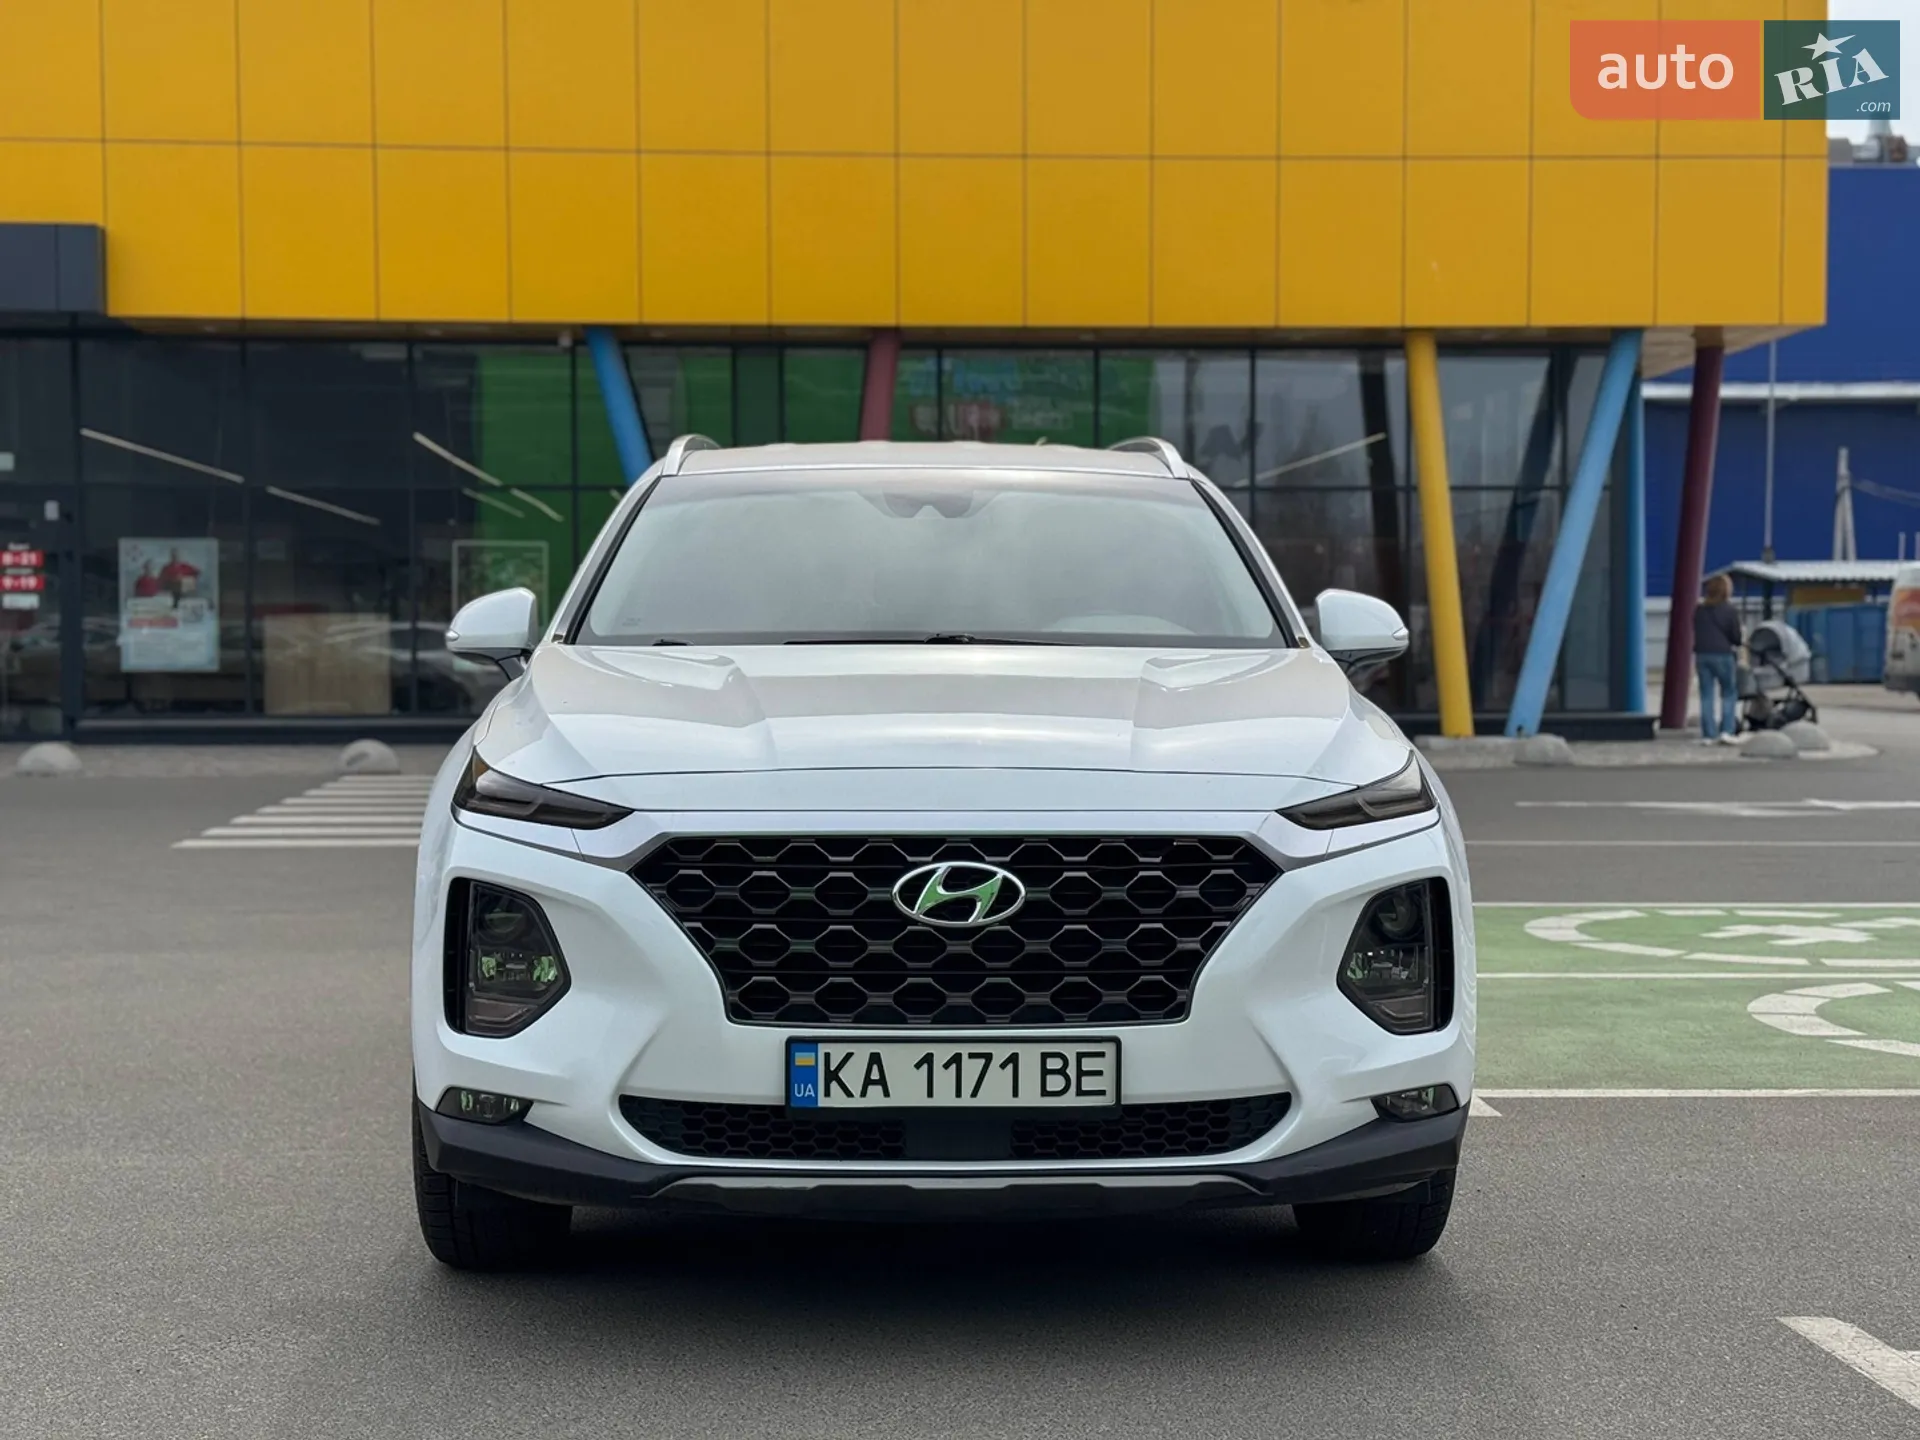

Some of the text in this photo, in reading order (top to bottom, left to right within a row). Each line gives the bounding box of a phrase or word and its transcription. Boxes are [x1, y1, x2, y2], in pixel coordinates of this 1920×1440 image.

[823, 1051, 1106, 1098] KA 1171 BE
[794, 1083, 815, 1097] UA
